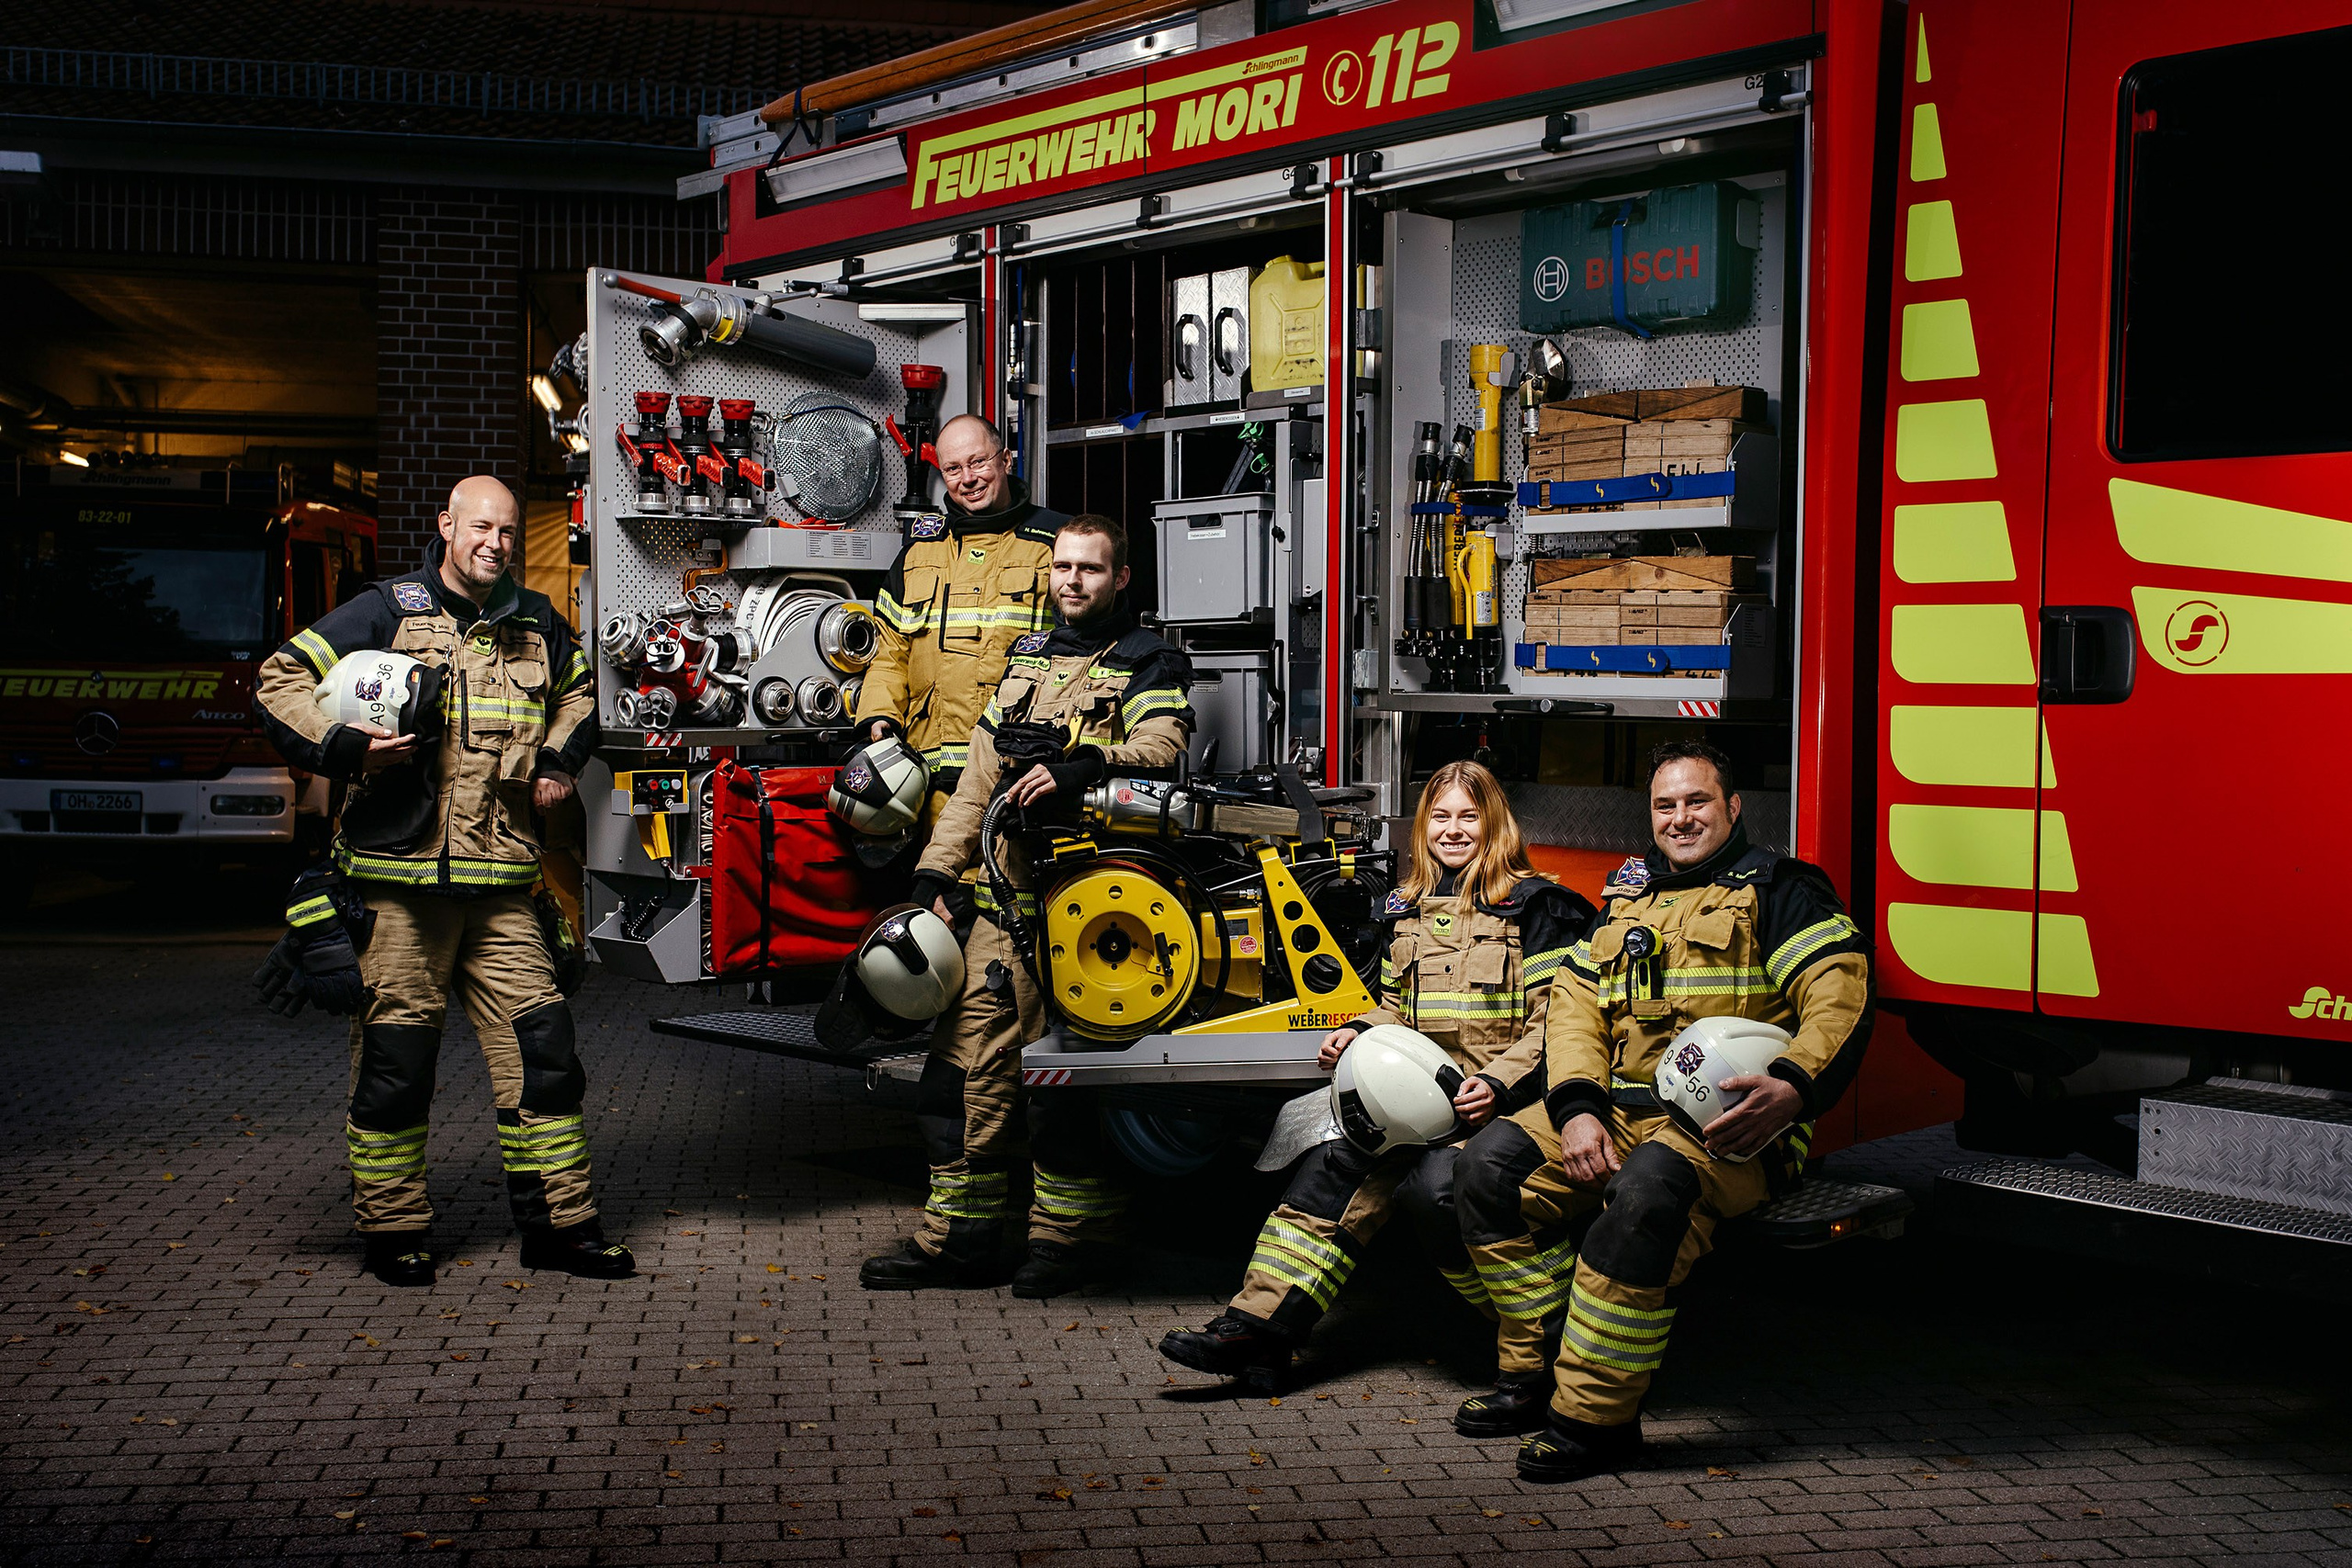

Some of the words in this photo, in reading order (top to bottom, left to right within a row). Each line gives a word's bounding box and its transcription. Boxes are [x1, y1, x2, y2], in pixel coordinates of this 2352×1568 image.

[1242, 53, 1299, 75] Schlingmann
[1365, 20, 1461, 109] 112
[1745, 74, 1764, 90] G2
[910, 108, 1158, 209] FEUERWEHR
[1172, 73, 1304, 152] MORI
[377, 662, 393, 681] 36
[0, 671, 220, 700] EUERWEHR
[368, 702, 386, 728] A9
[1131, 781, 1150, 793] SP
[68, 795, 87, 809] OH
[97, 795, 132, 810] 2266
[1685, 1076, 1711, 1102] 56
